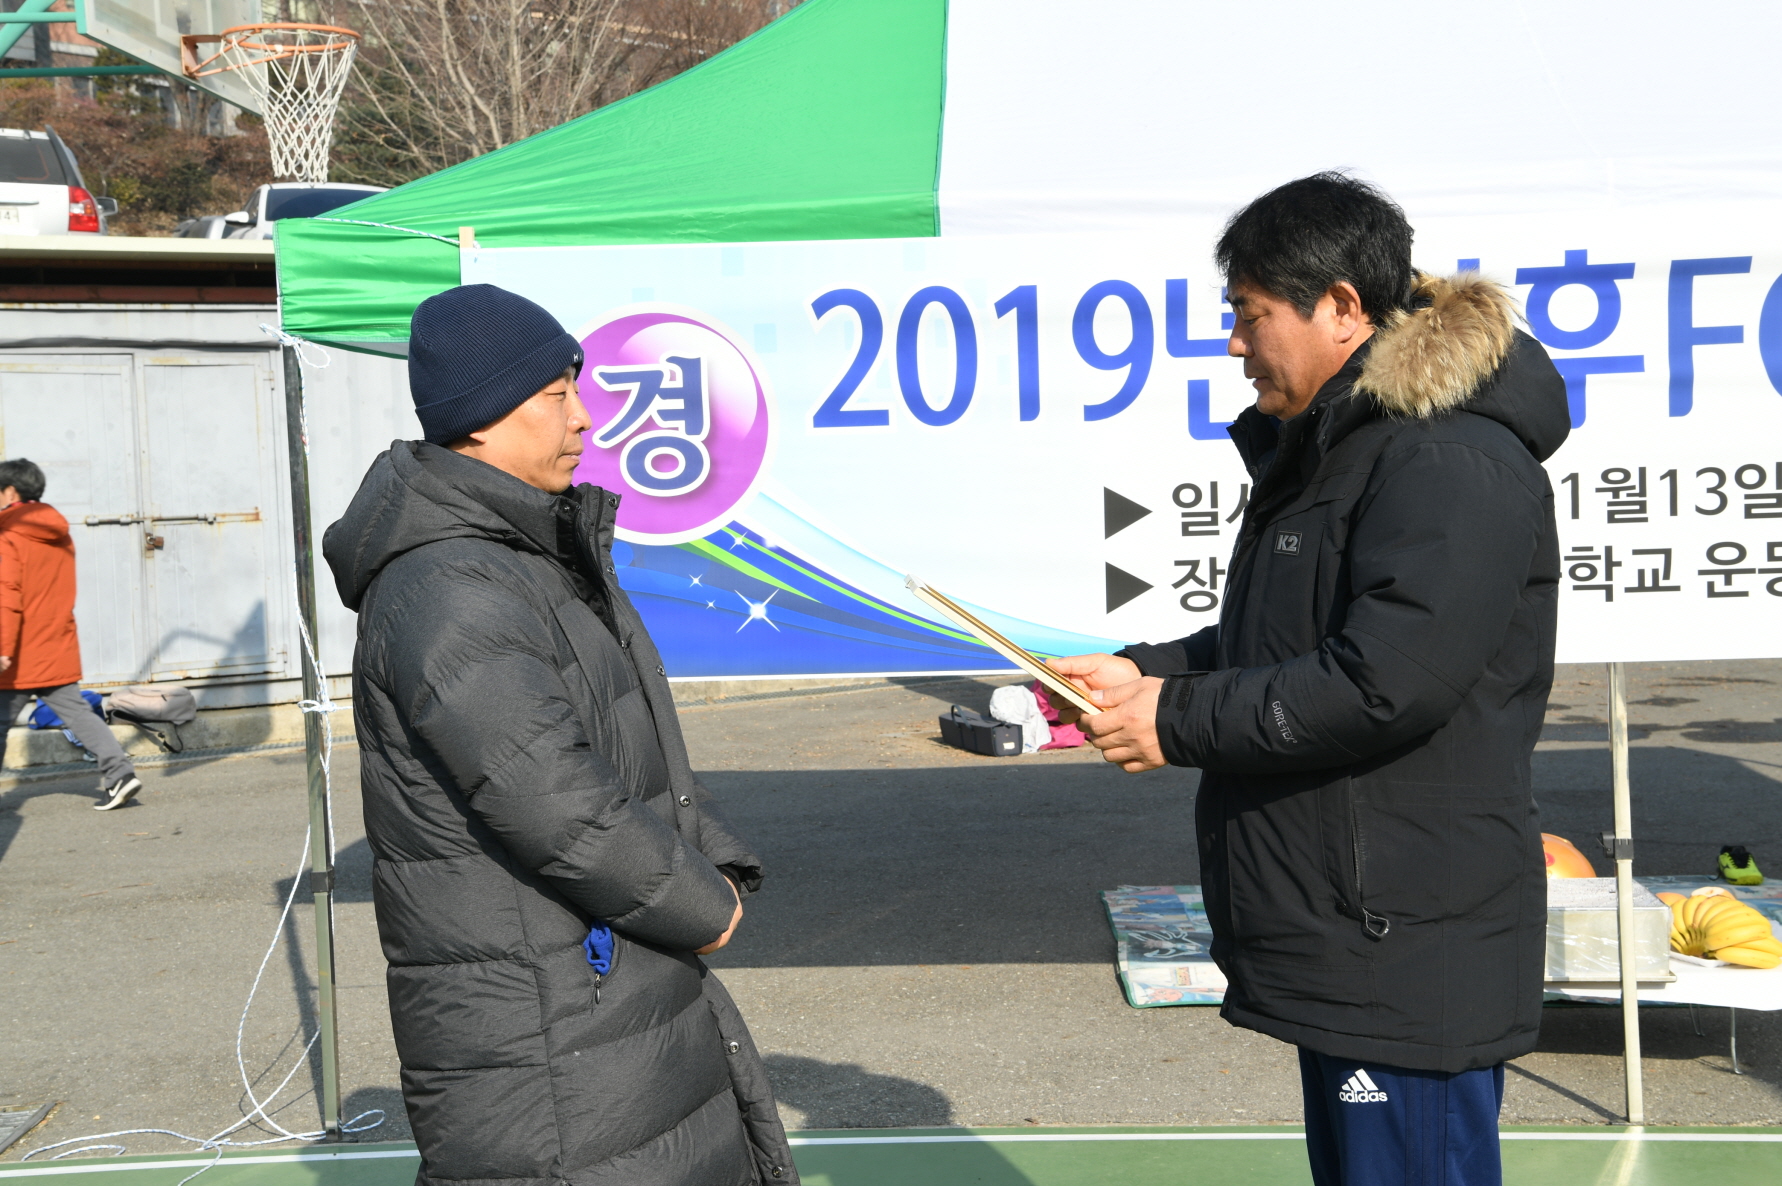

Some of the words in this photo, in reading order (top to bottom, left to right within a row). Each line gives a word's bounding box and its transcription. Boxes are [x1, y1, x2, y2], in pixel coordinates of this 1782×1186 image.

[595, 353, 707, 493] 경
[1277, 534, 1299, 551] K2
[1560, 545, 1681, 602] 학교
[1339, 1090, 1388, 1103] adidas
